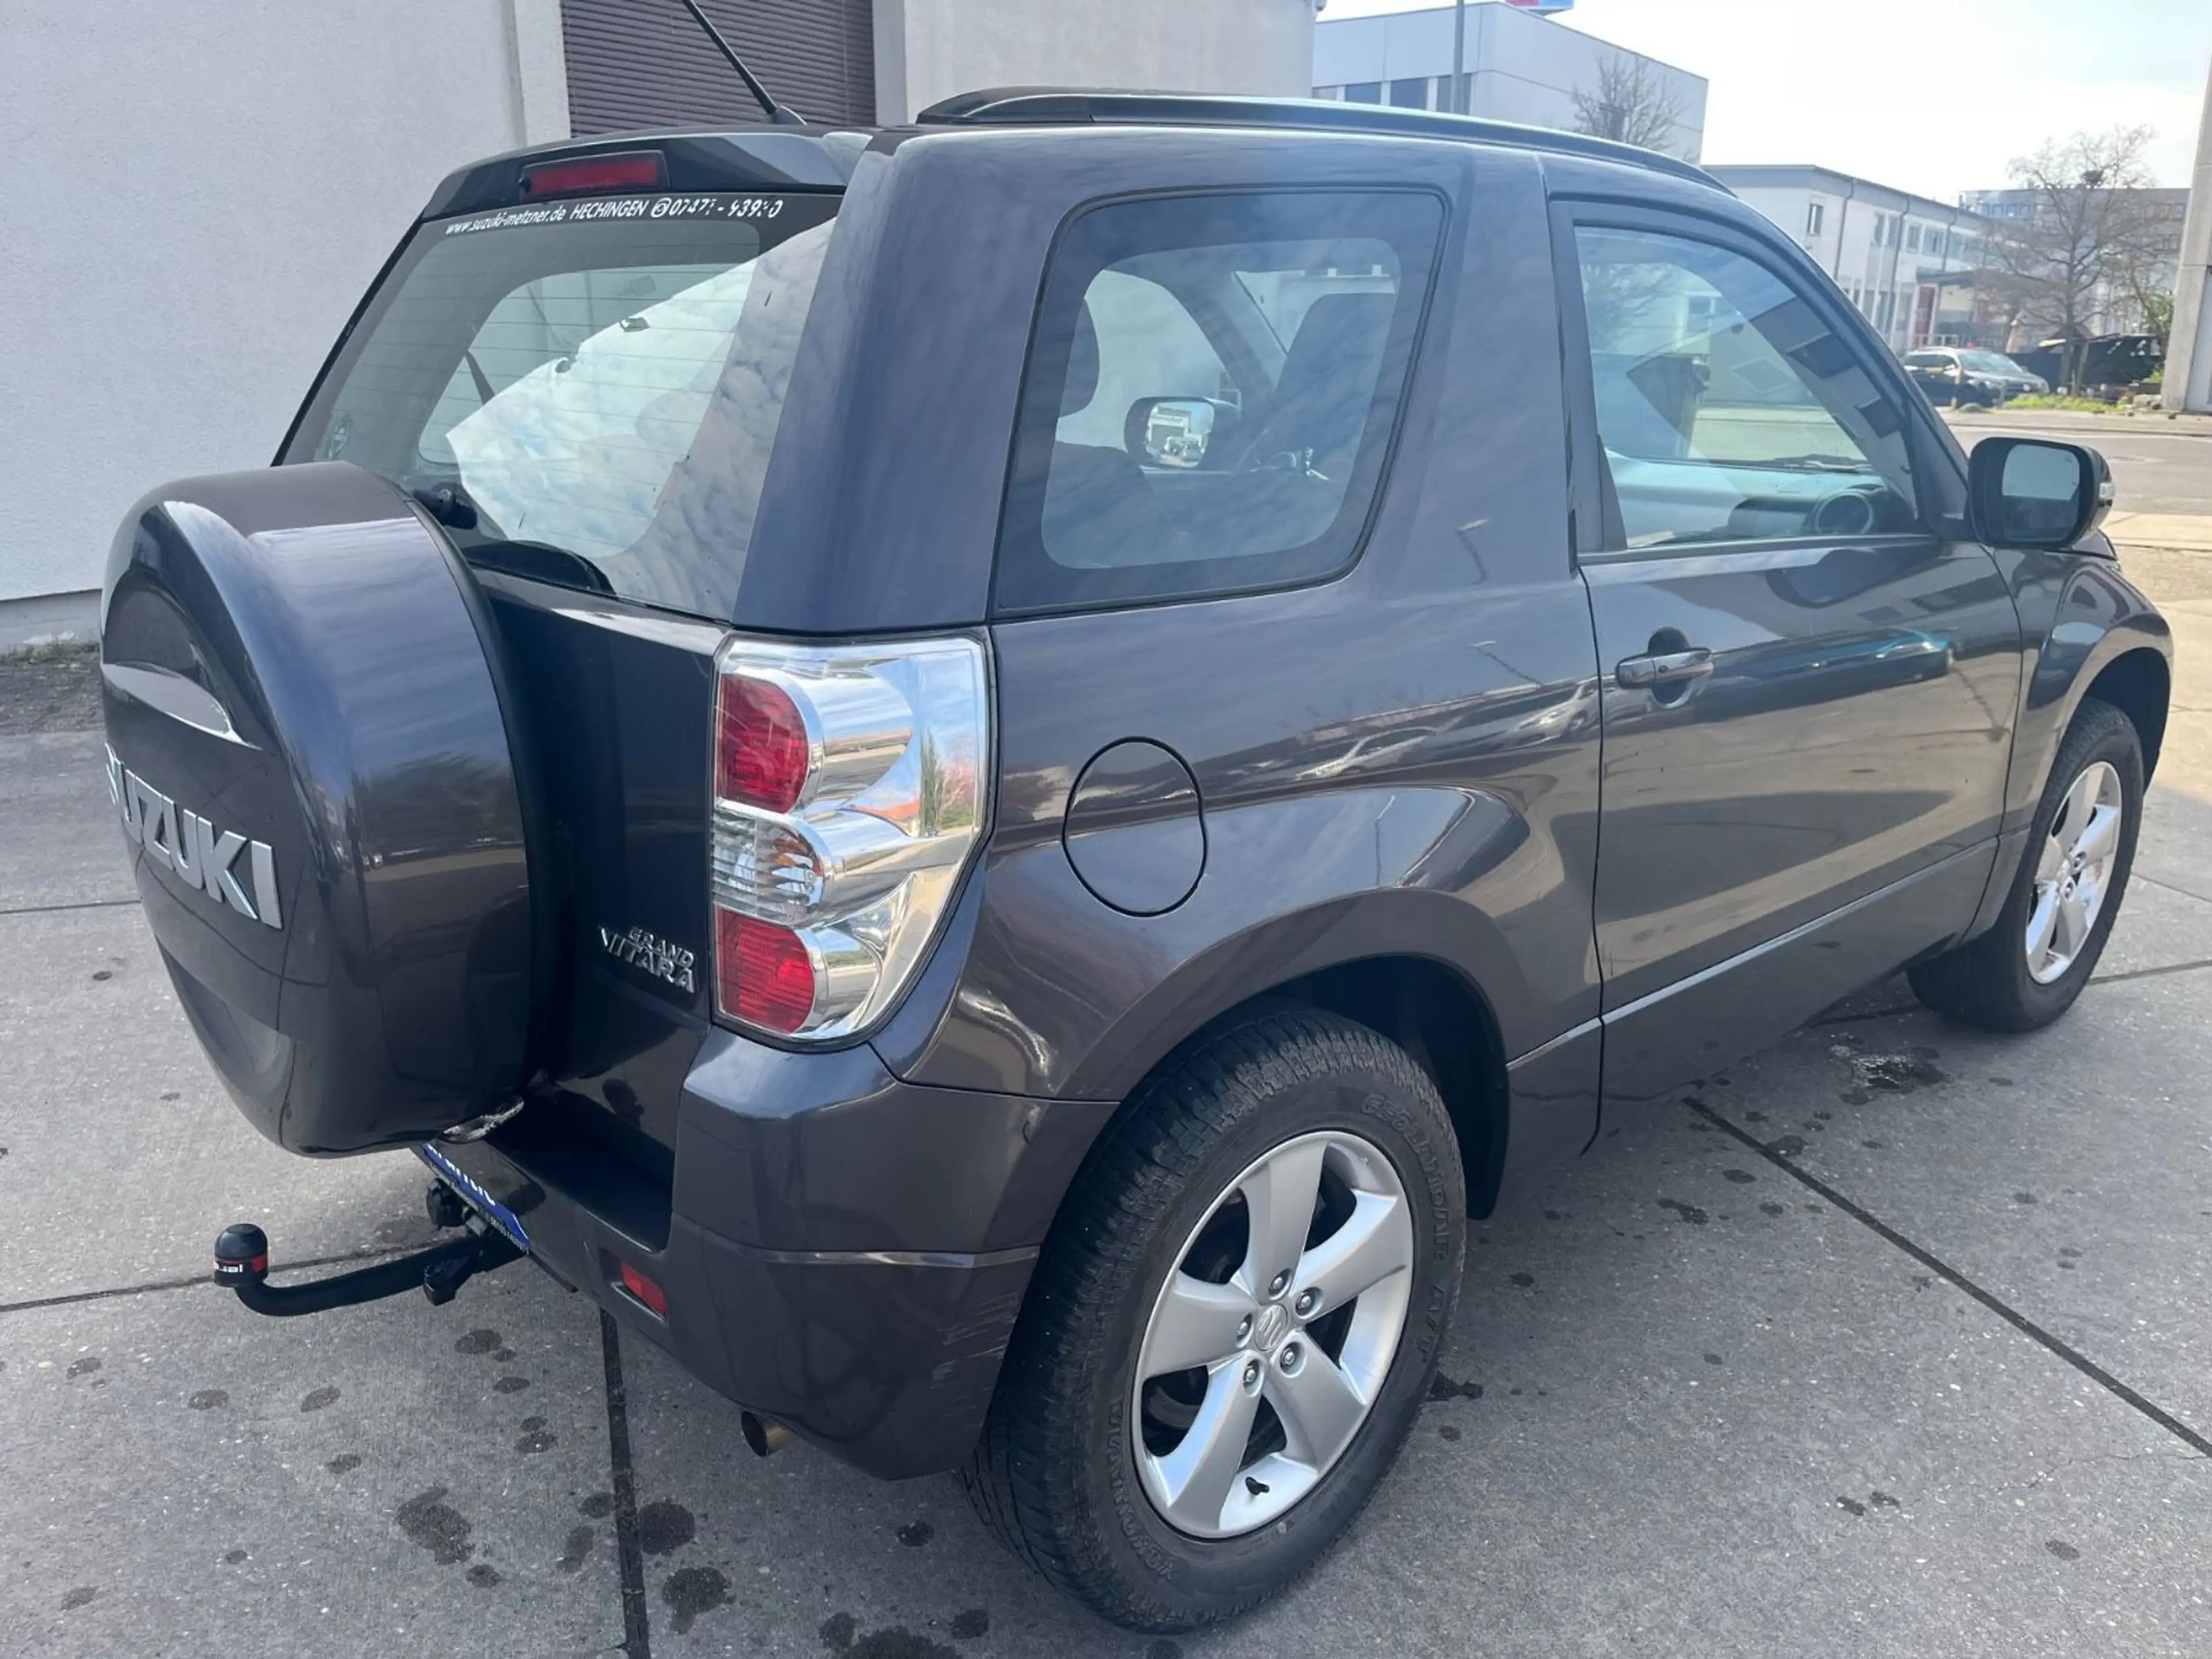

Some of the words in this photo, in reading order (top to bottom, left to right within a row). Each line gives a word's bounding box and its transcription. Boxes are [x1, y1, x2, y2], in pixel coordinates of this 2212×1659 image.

[569, 200, 649, 219] HECHINGEN
[600, 926, 695, 993] VITARA
[628, 927, 695, 969] GRAND
